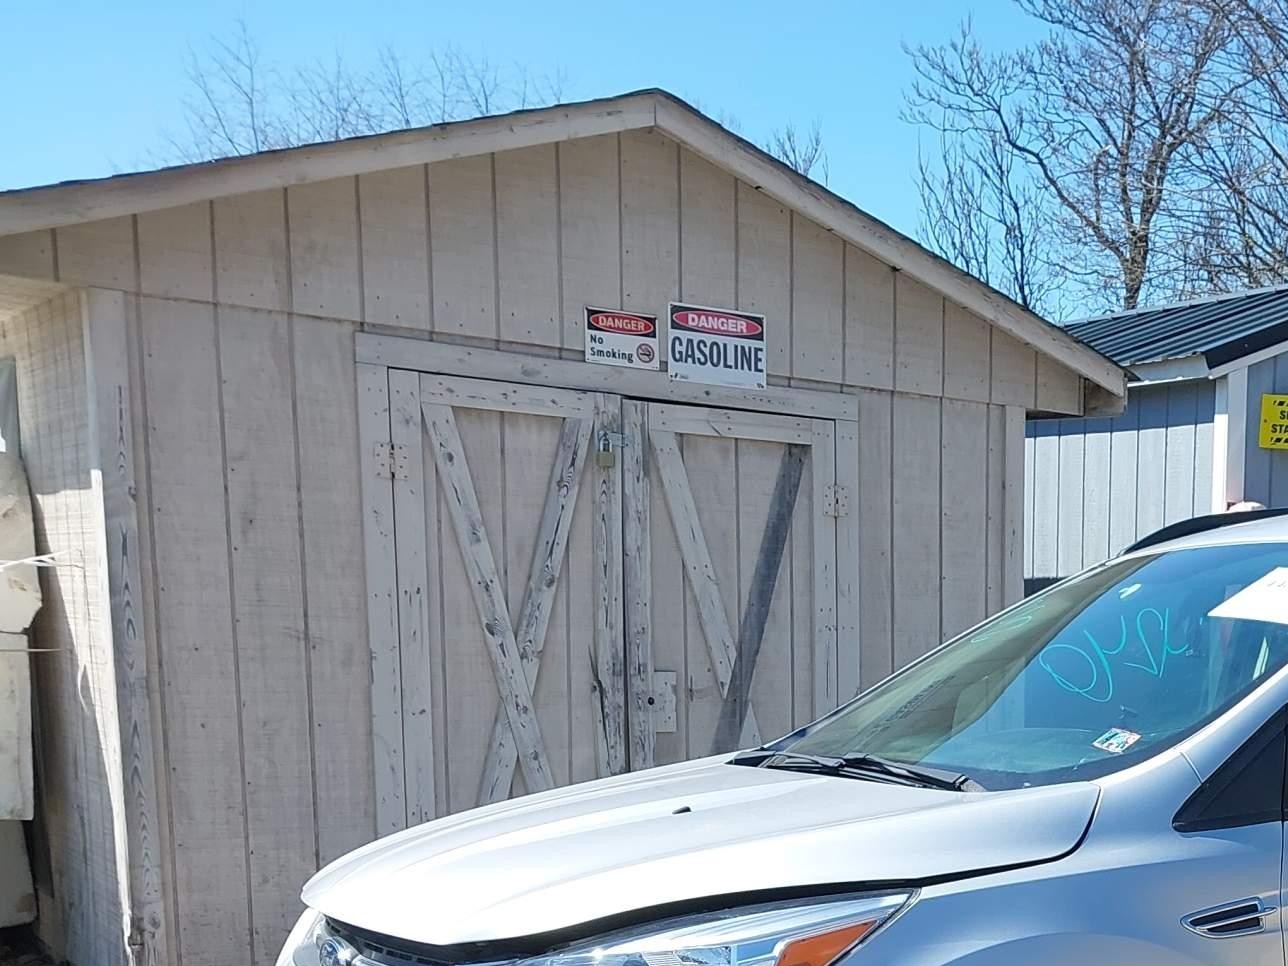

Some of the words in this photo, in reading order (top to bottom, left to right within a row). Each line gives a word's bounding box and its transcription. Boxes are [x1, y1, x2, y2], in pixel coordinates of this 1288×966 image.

[598, 315, 646, 332] DANGER
[687, 313, 748, 333] DANGER
[590, 334, 604, 345] No
[590, 347, 633, 363] Smoking
[671, 335, 764, 373] GASOLINE
